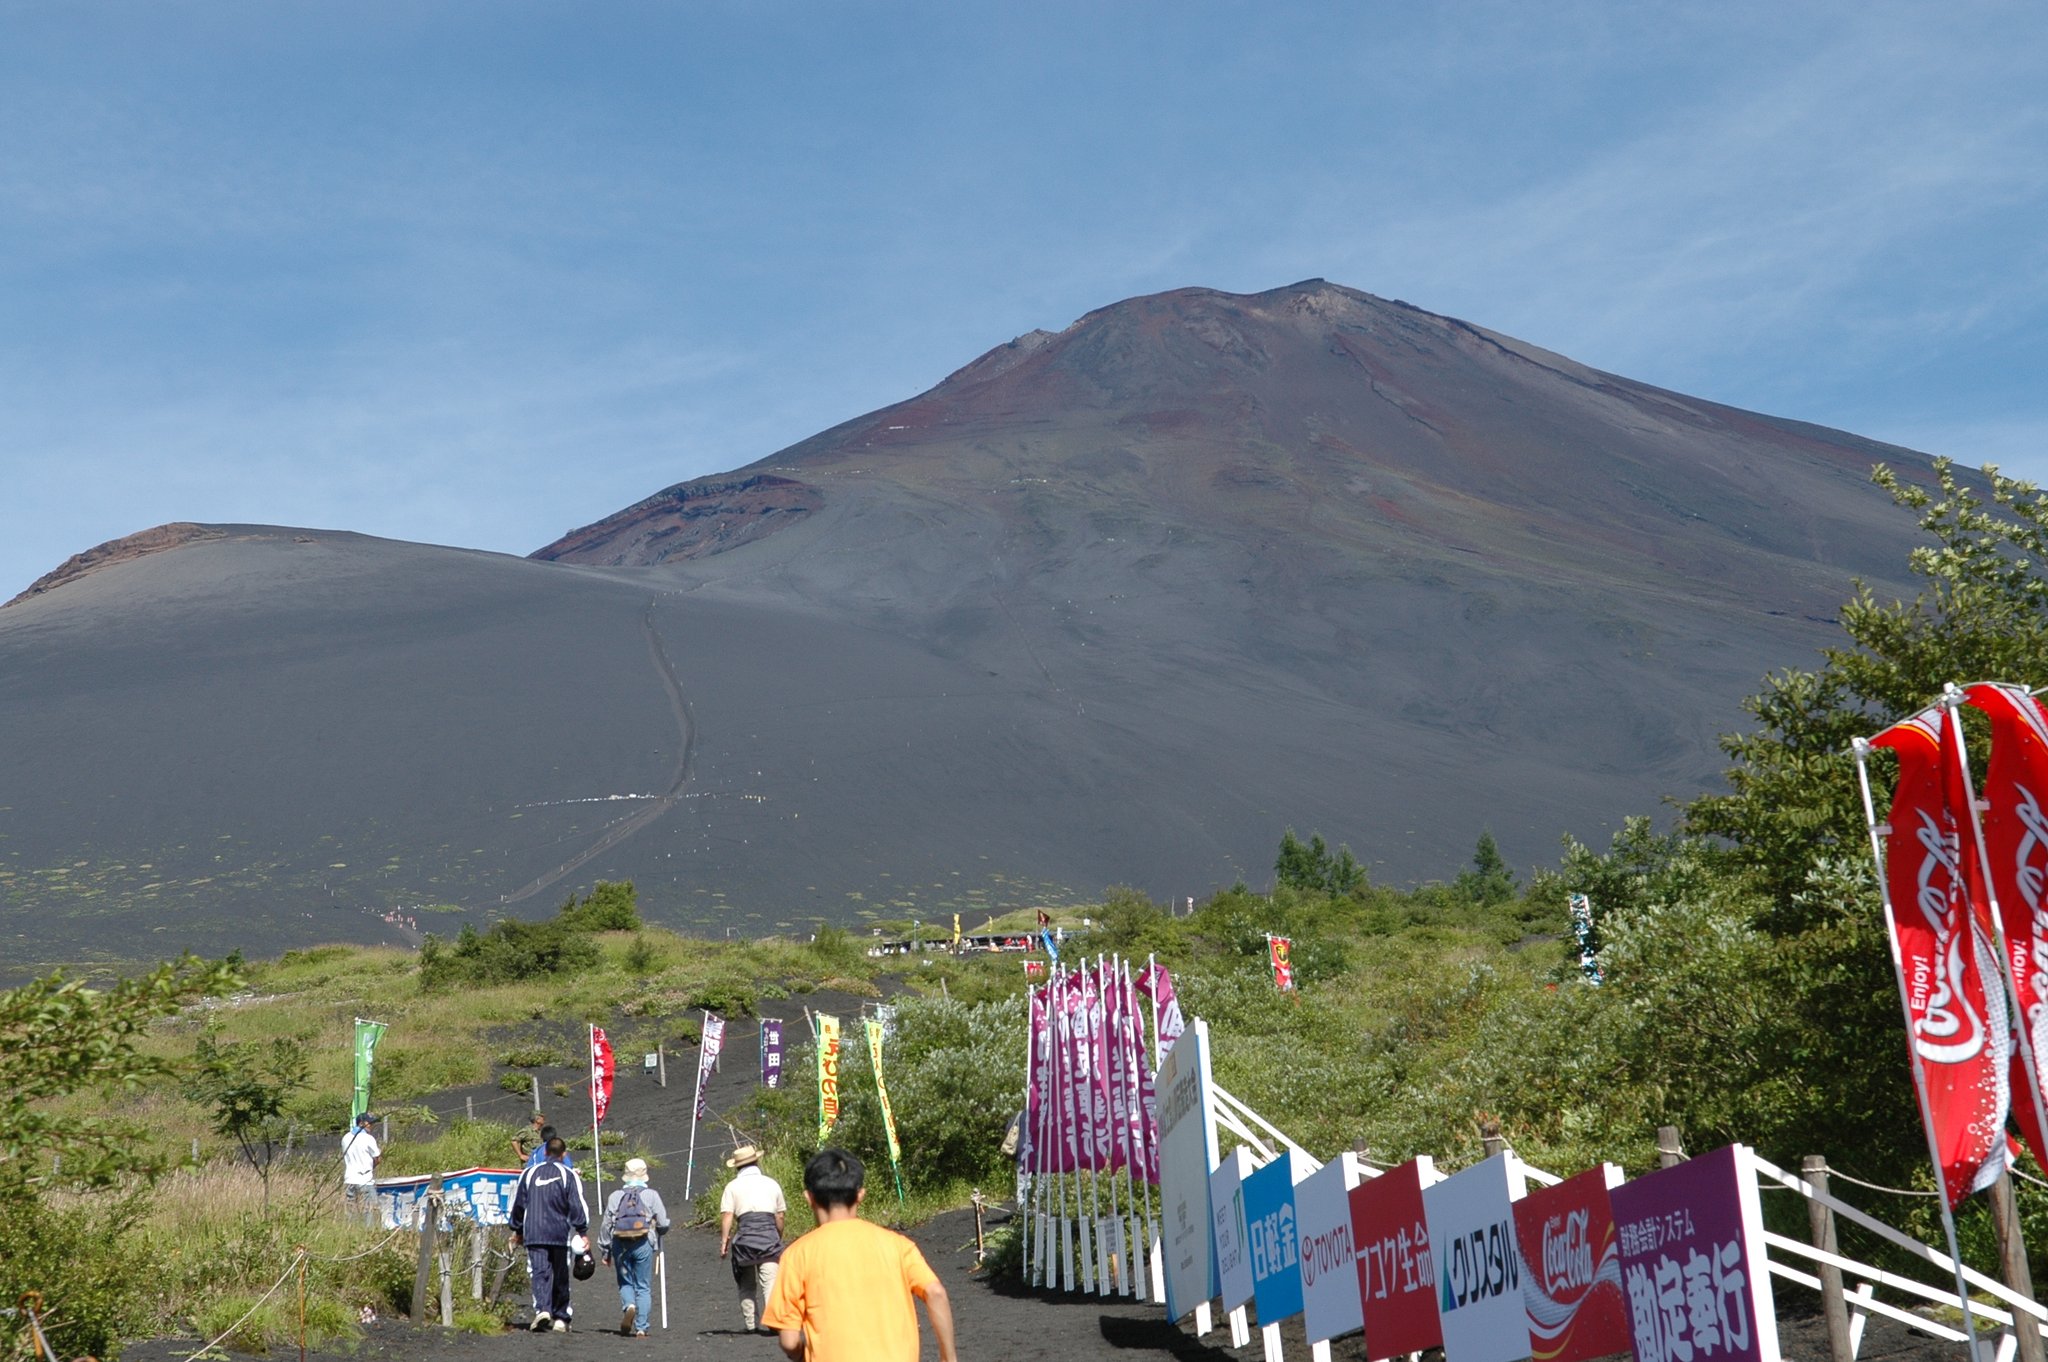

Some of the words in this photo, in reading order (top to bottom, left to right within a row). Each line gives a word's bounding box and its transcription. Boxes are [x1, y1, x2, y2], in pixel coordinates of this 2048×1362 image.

[1910, 955, 1928, 1011] Enjoy!
[1249, 1202, 1298, 1282] 日軽金
[1314, 1223, 1353, 1275] TOYOTA
[1356, 1221, 1435, 1302] フコク生命
[1452, 1220, 1519, 1307] クリスタル
[1542, 1207, 1594, 1296] Coca-Cola
[1619, 1208, 1696, 1257] 財務会計システム
